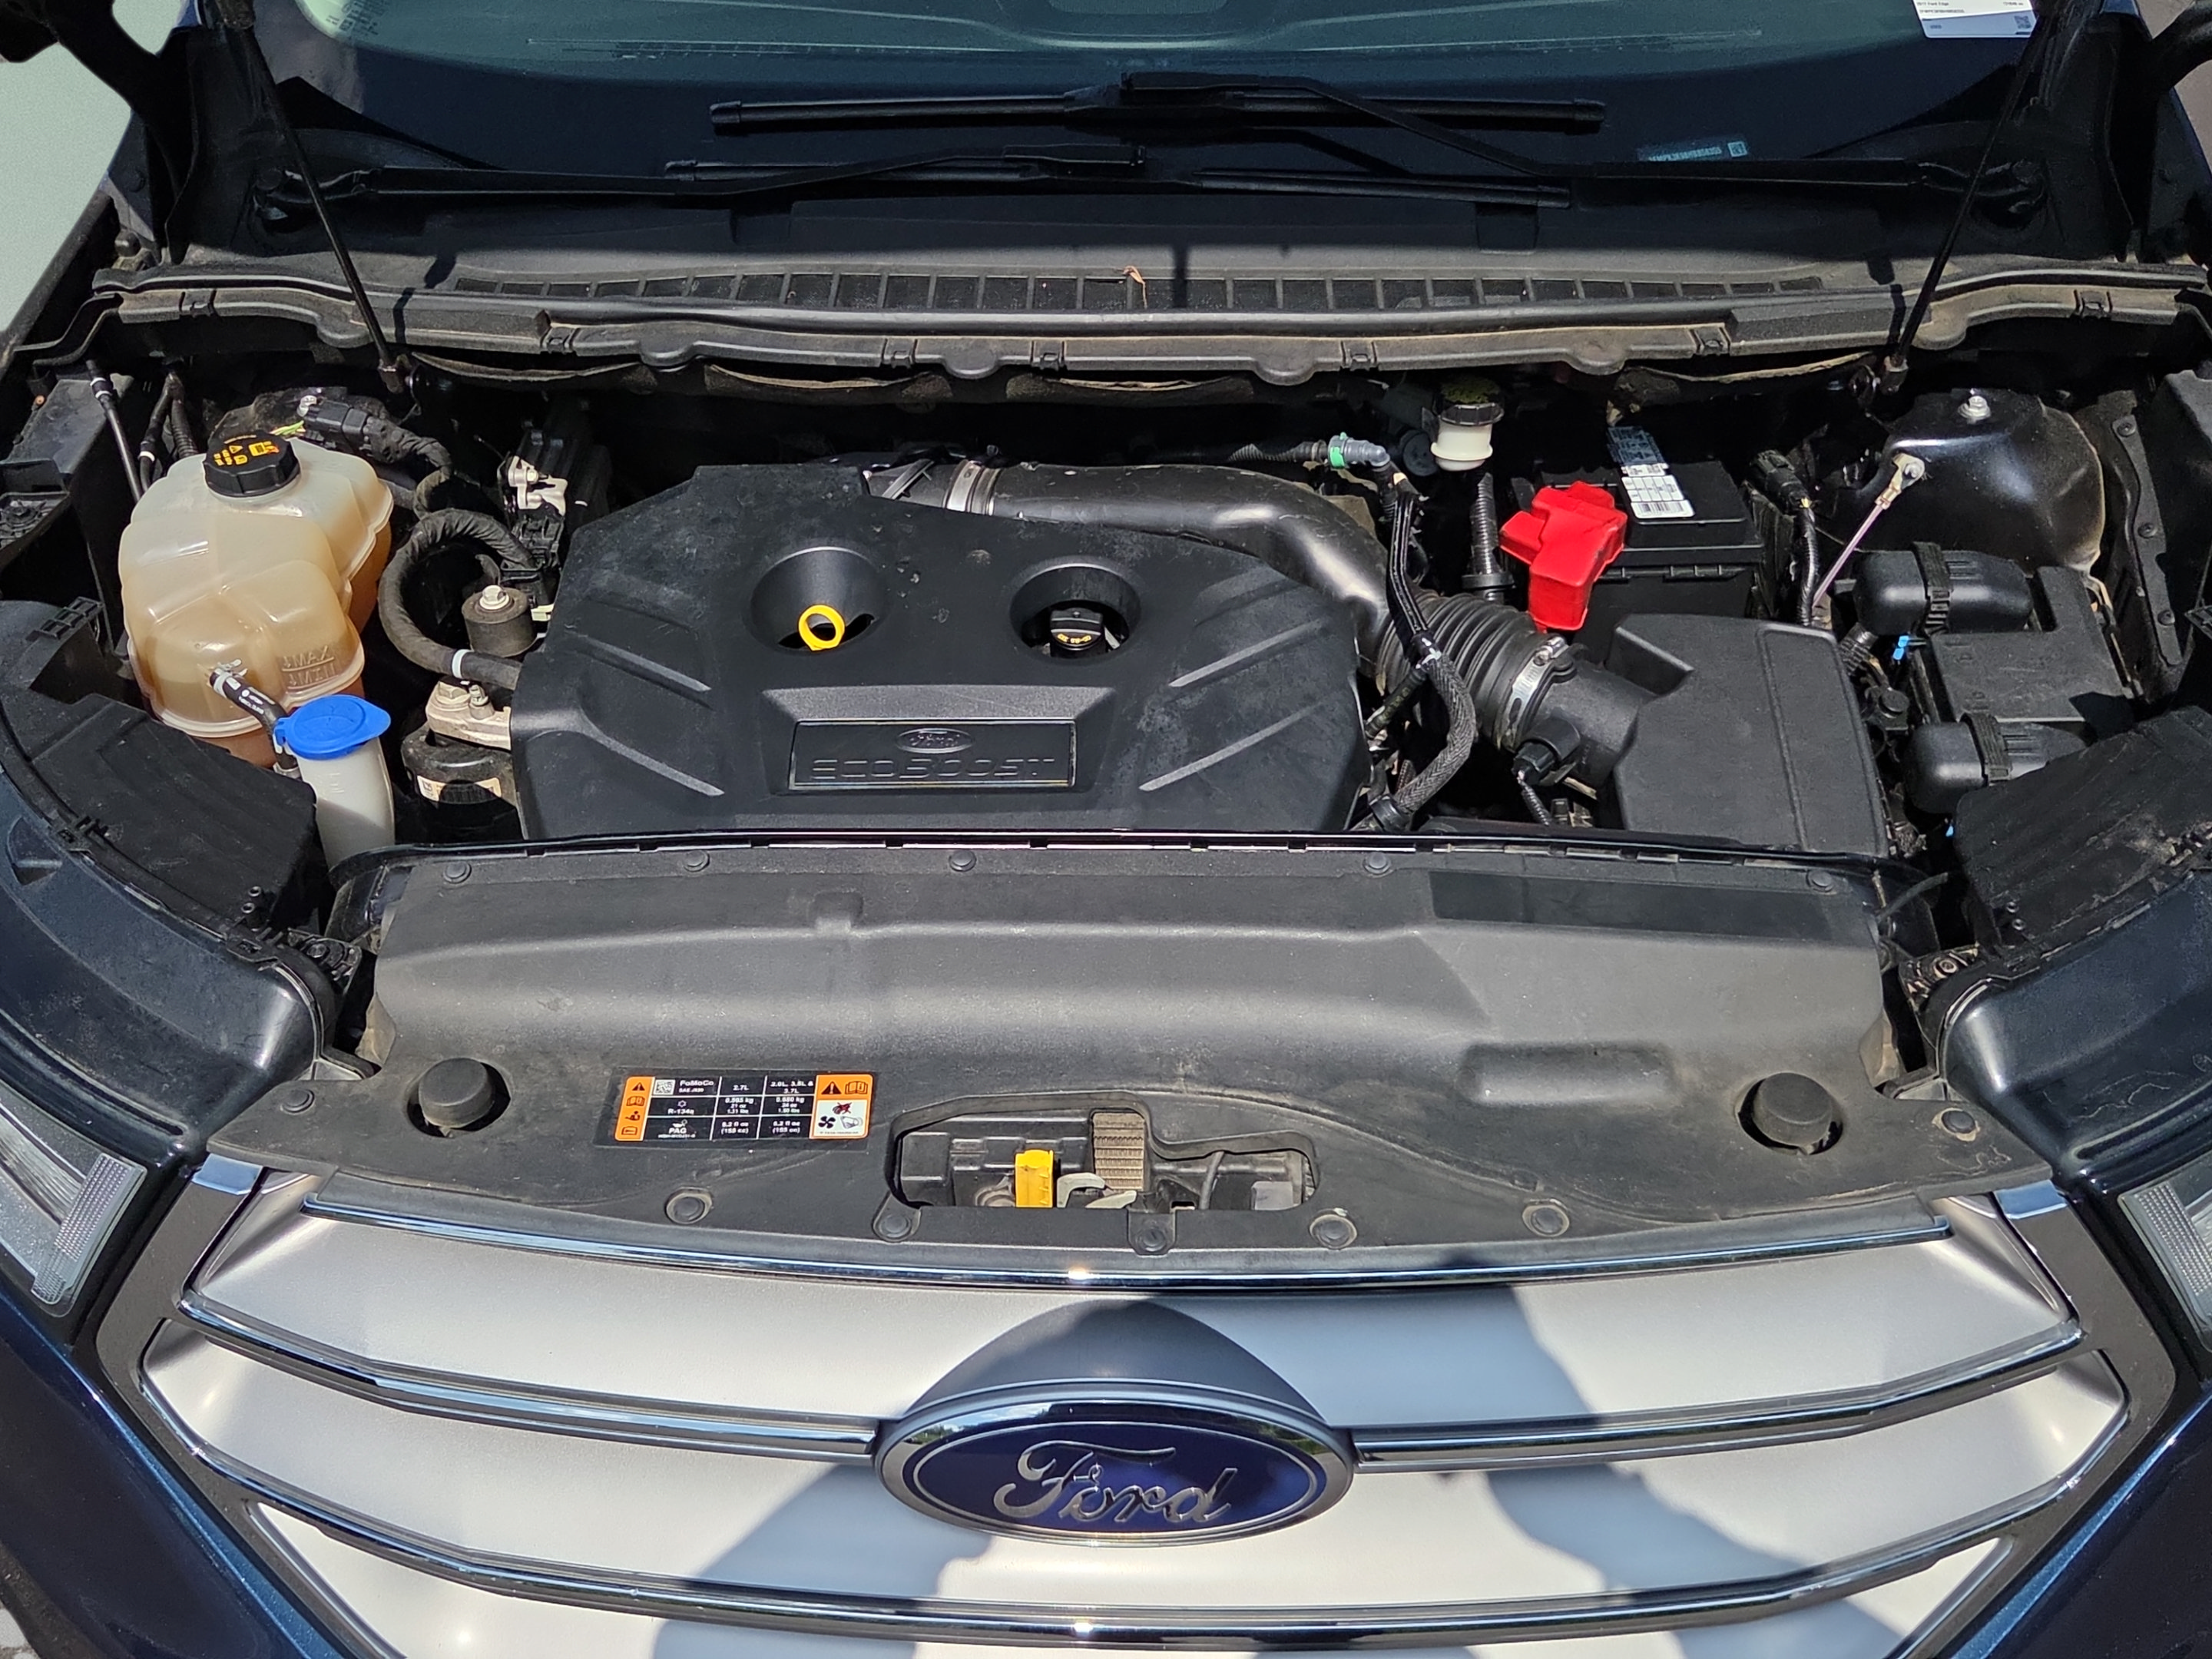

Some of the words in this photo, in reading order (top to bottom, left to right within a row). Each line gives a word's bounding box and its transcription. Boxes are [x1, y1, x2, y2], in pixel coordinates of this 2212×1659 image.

[292, 644, 329, 667] MAX
[810, 758, 1055, 780] ECOBOOST
[993, 1439, 1238, 1524] Ford
